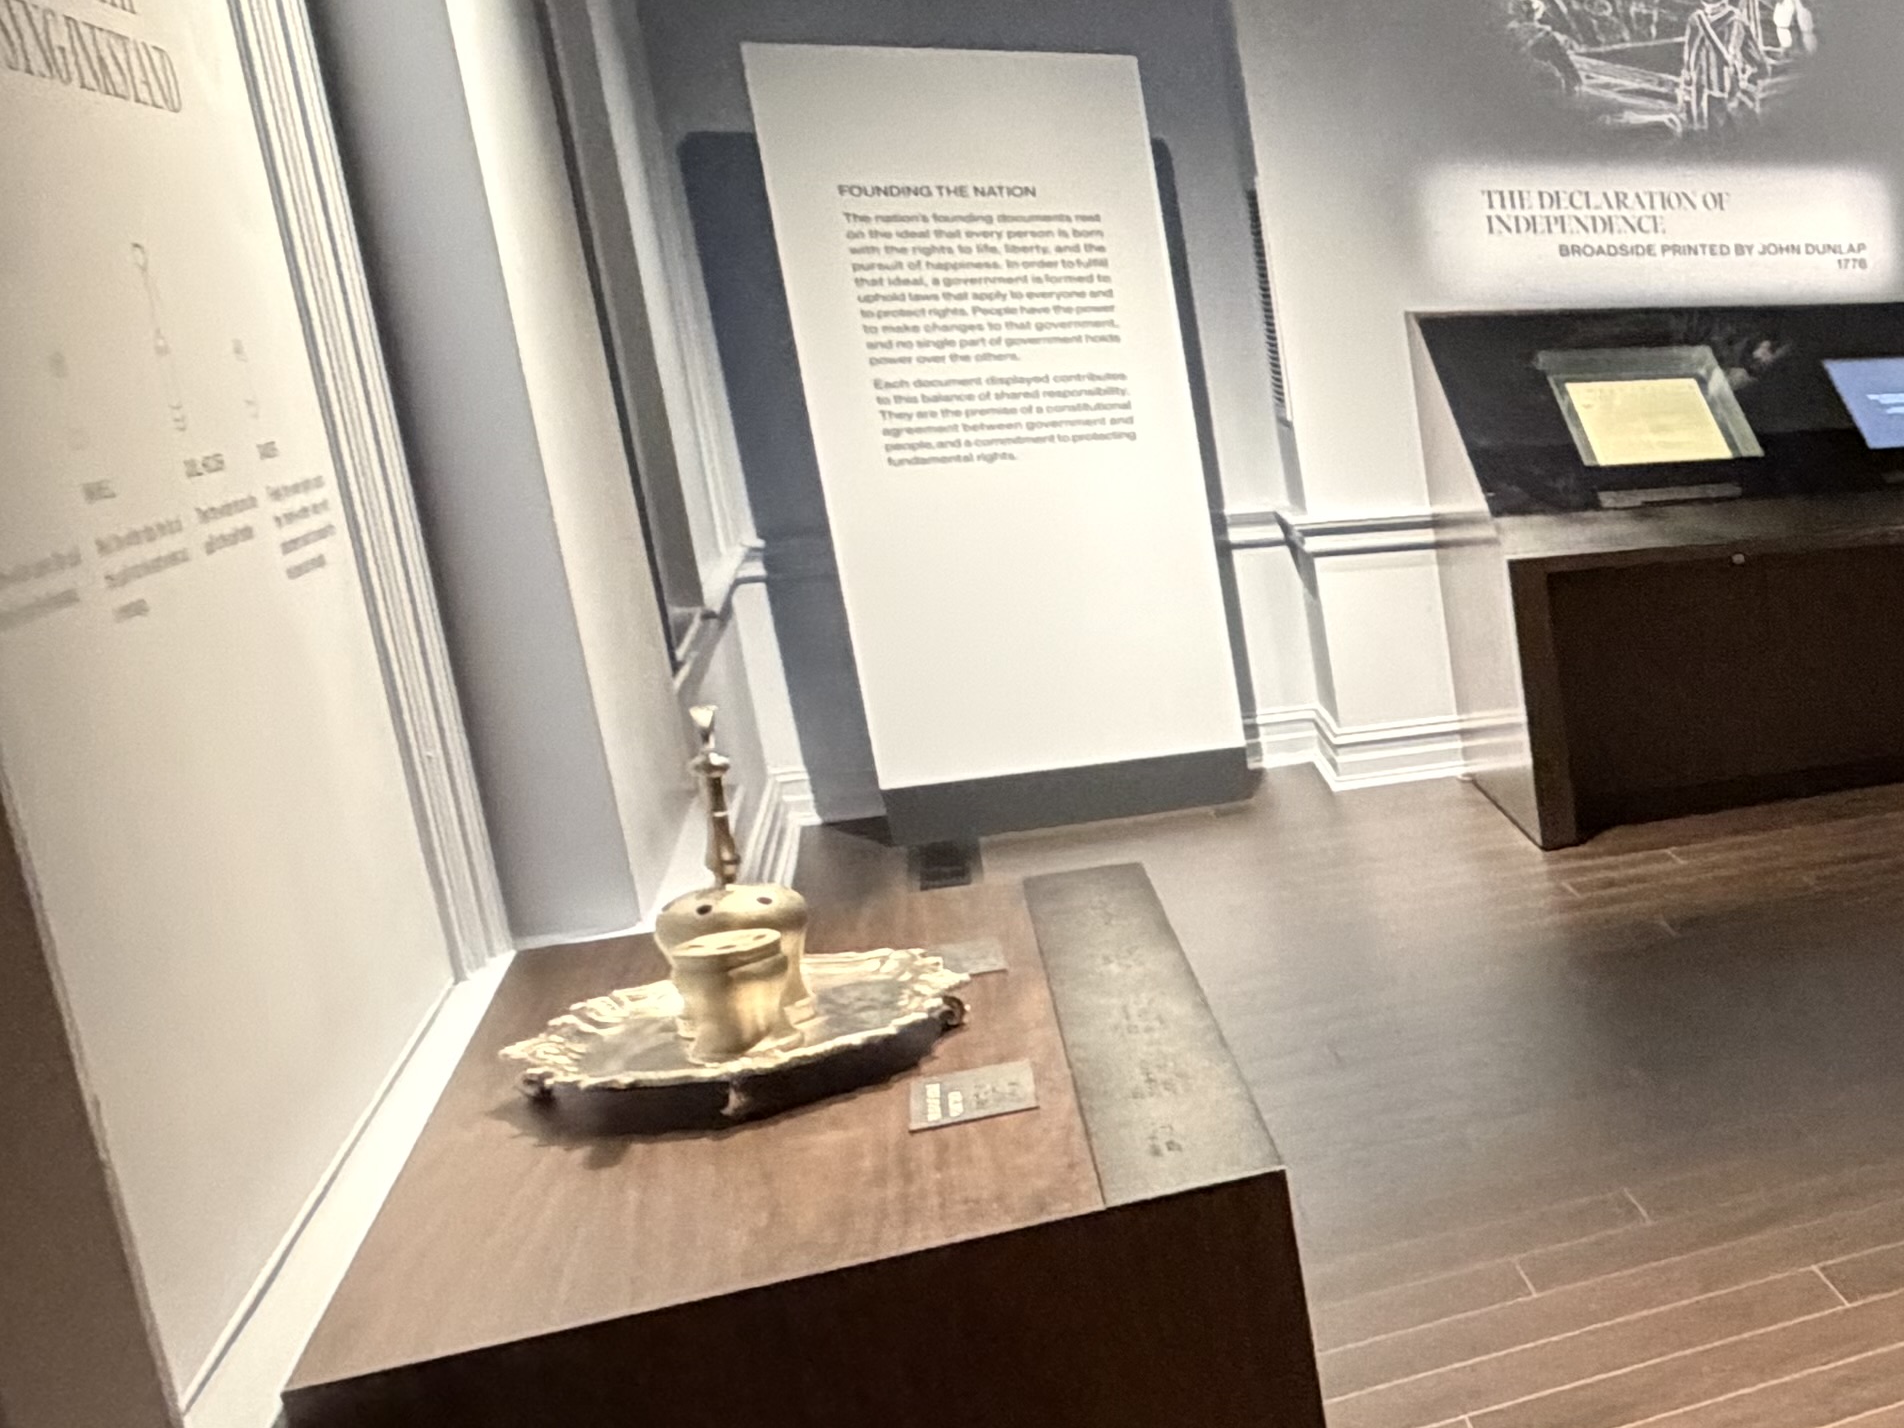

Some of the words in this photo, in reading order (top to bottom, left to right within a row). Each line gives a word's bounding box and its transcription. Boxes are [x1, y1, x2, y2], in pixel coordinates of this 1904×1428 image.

[838, 184, 932, 197] FOUNDING
[936, 185, 970, 197] THE
[973, 185, 1036, 197] NATION
[1481, 190, 1531, 211] THE
[1538, 190, 1697, 211] DECLARATION
[1703, 191, 1731, 212] OF
[843, 211, 872, 223] The
[933, 212, 993, 225] founding
[997, 213, 1072, 223] documents
[1485, 214, 1666, 235] INDEPENDENCE
[868, 229, 893, 239] the
[896, 229, 930, 239] ideal
[934, 229, 961, 239] that
[965, 231, 1003, 241] every
[1006, 231, 1054, 241] person
[1057, 229, 1069, 238] is
[1072, 229, 1104, 238] born
[884, 245, 908, 255] the
[912, 245, 954, 257] rights
[958, 245, 973, 255] to
[1054, 245, 1081, 253] and
[1084, 244, 1106, 253] the
[1558, 243, 1657, 257] BROADSIDE
[1661, 243, 1730, 257] PRINTED
[1734, 243, 1754, 257] BY
[1757, 242, 1801, 257] JOHN
[1805, 242, 1868, 256] DUNLAP
[852, 261, 903, 272] pursuit
[907, 260, 921, 270] of
[1021, 260, 1059, 270] order
[1061, 259, 1075, 269] to
[854, 276, 884, 287] that
[931, 277, 940, 286] a
[942, 275, 1028, 287] government
[1031, 275, 1043, 284] is
[1044, 274, 1094, 284] formed
[1097, 274, 1112, 283] to
[857, 293, 906, 303] uphold
[942, 292, 968, 301] that
[971, 292, 1007, 303] apply
[1009, 290, 1024, 299] to
[1026, 290, 1086, 301] everyone
[1089, 289, 1113, 299] and
[860, 309, 875, 318] to
[971, 306, 1018, 317] People
[1019, 306, 1050, 315] have
[1052, 305, 1074, 314] the
[862, 325, 878, 334] to
[881, 324, 920, 333] make
[923, 323, 985, 334] changes
[987, 322, 1002, 331] to
[1004, 320, 1031, 331] that
[866, 340, 893, 350] and
[896, 340, 914, 349] no
[916, 339, 956, 350] single
[959, 338, 986, 349] part
[988, 336, 1002, 346] of
[1004, 336, 1082, 347] government
[869, 357, 912, 367] power
[916, 356, 946, 364] over
[949, 353, 971, 363] the
[873, 378, 910, 390] Each
[913, 377, 982, 388] document
[985, 375, 1050, 386] displayed
[1052, 373, 1128, 383] contributes
[876, 395, 891, 405] to
[893, 394, 918, 404] this
[921, 393, 975, 403] balance
[978, 391, 991, 401] of
[994, 390, 1039, 400] shared
[880, 410, 914, 421] They
[916, 410, 938, 419] are
[941, 408, 962, 418] the
[1020, 405, 1033, 415] of
[1035, 406, 1043, 414] a
[1046, 401, 1132, 413] constitutional
[882, 424, 959, 438] agreement
[962, 422, 1022, 432] between
[1025, 418, 1106, 431] government
[1109, 416, 1134, 426] and
[936, 439, 961, 449] and
[1057, 434, 1070, 443] to
[887, 453, 974, 467] fundamental
